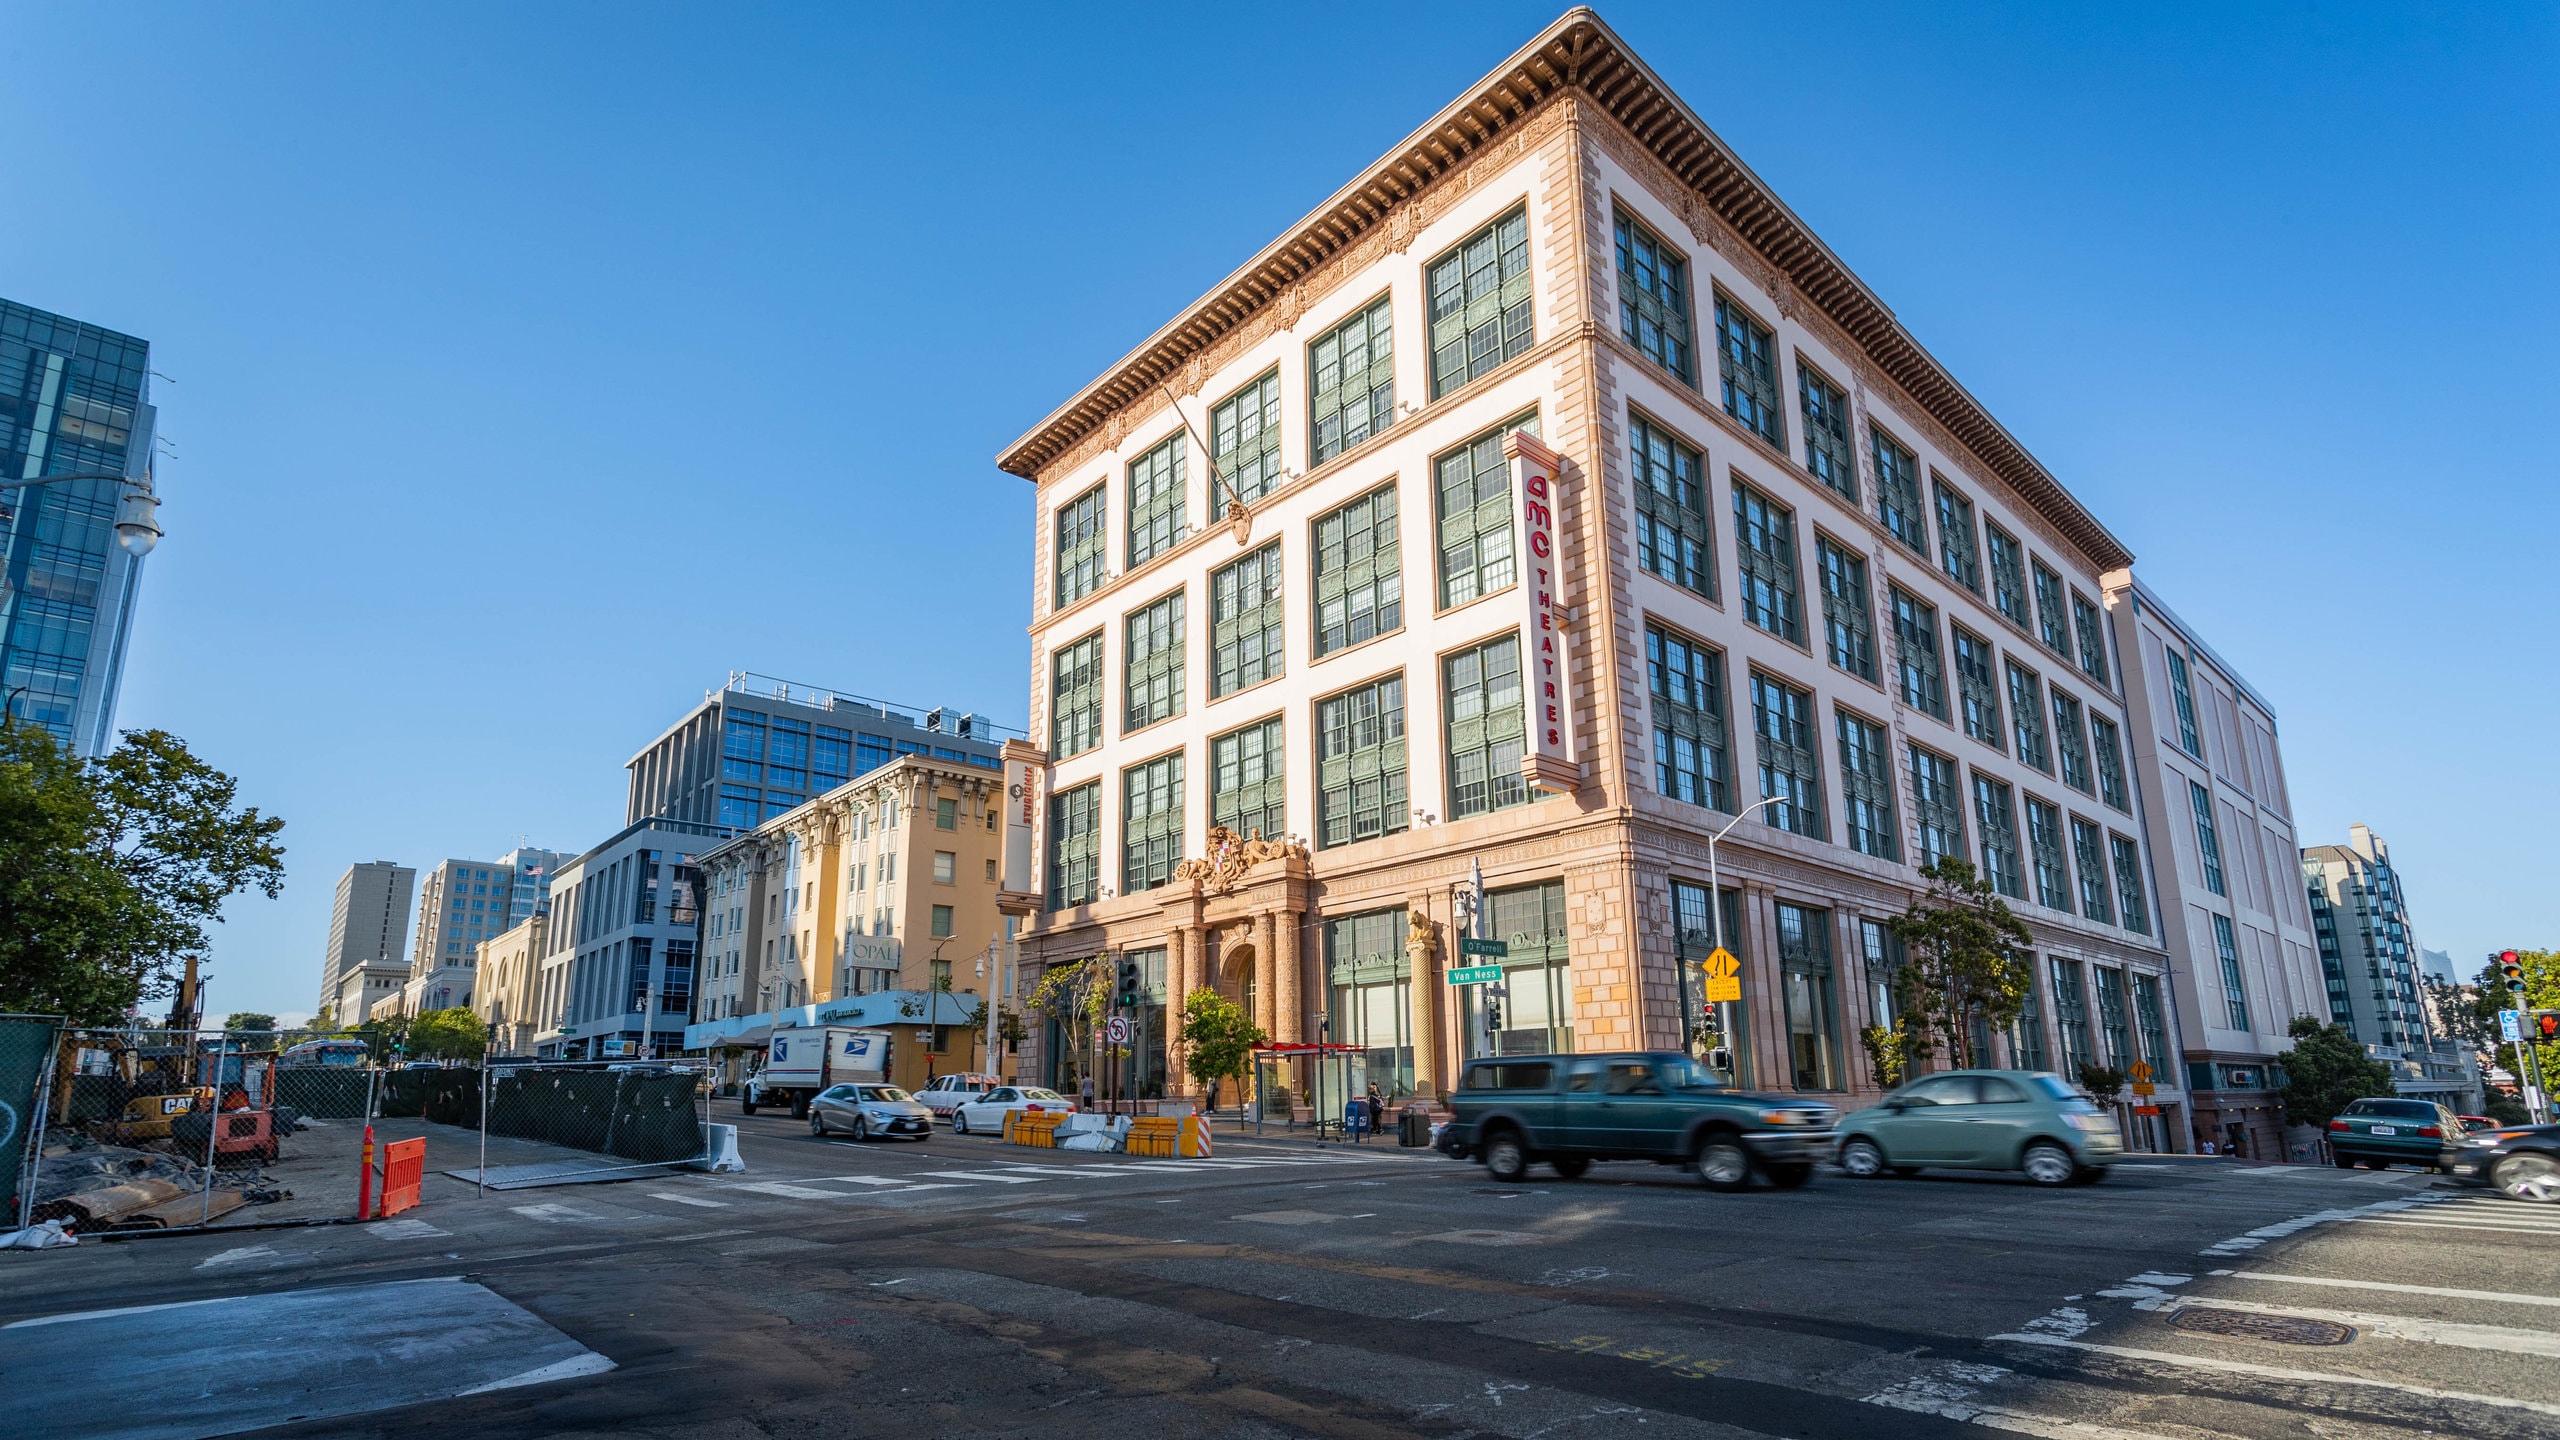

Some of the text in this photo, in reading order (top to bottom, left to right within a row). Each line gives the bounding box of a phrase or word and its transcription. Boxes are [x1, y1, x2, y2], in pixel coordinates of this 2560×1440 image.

[1537, 567, 1559, 746] THEATRES
[1024, 766, 1032, 824] STUDIOMIX
[853, 944, 896, 960] OPAL
[1468, 941, 1501, 953] O'Farrell
[1454, 970, 1496, 980] Van Ness
[164, 1097, 193, 1114] CAT
